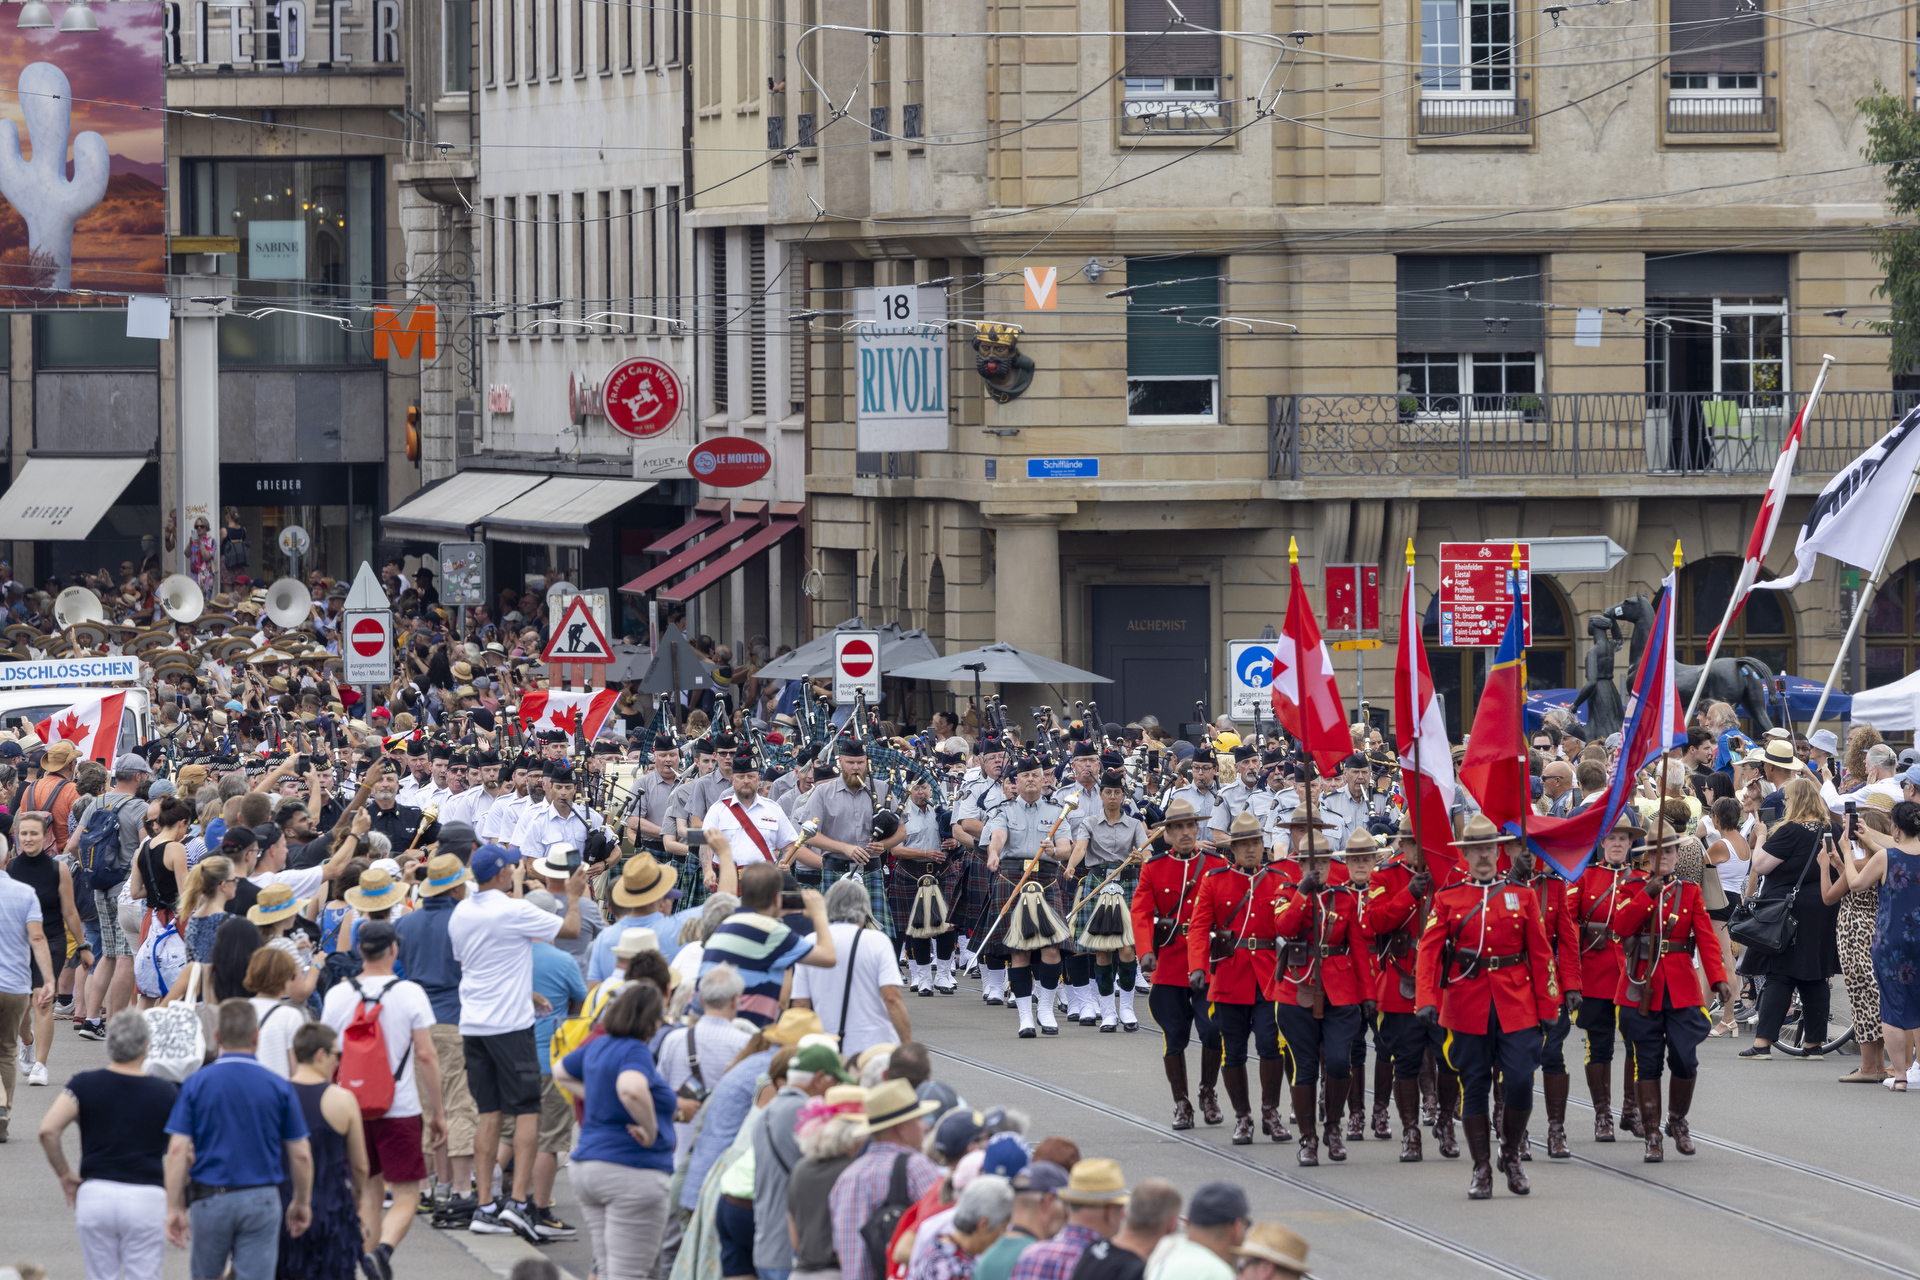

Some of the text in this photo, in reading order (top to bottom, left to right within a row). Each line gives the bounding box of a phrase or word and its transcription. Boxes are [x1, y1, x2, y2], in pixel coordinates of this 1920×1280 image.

[255, 241, 299, 252] SABINE
[1024, 267, 1057, 310] V
[883, 294, 910, 320] 18
[374, 305, 436, 359] M
[608, 372, 628, 404] FRANZ
[628, 365, 653, 376] CARL
[656, 368, 674, 400] WEBER
[860, 346, 944, 413] RIVOLI
[643, 457, 676, 468] ATELIER
[716, 452, 766, 464] LE MOUTON
[1043, 460, 1083, 469] Schifflände
[256, 479, 301, 490] GRIEDER
[21, 506, 74, 519] GRIEDER
[1454, 563, 1483, 571] Rheinfelden
[1520, 570, 1528, 580] 3
[1454, 579, 1469, 587] Augst
[1520, 585, 1527, 594] 2
[1454, 605, 1475, 613] Freiburg
[1127, 619, 1188, 631] ALCHEMIST
[1454, 620, 1478, 628] Huningue
[1454, 628, 1482, 636] Saint-Louis
[1454, 636, 1480, 645] Binningen
